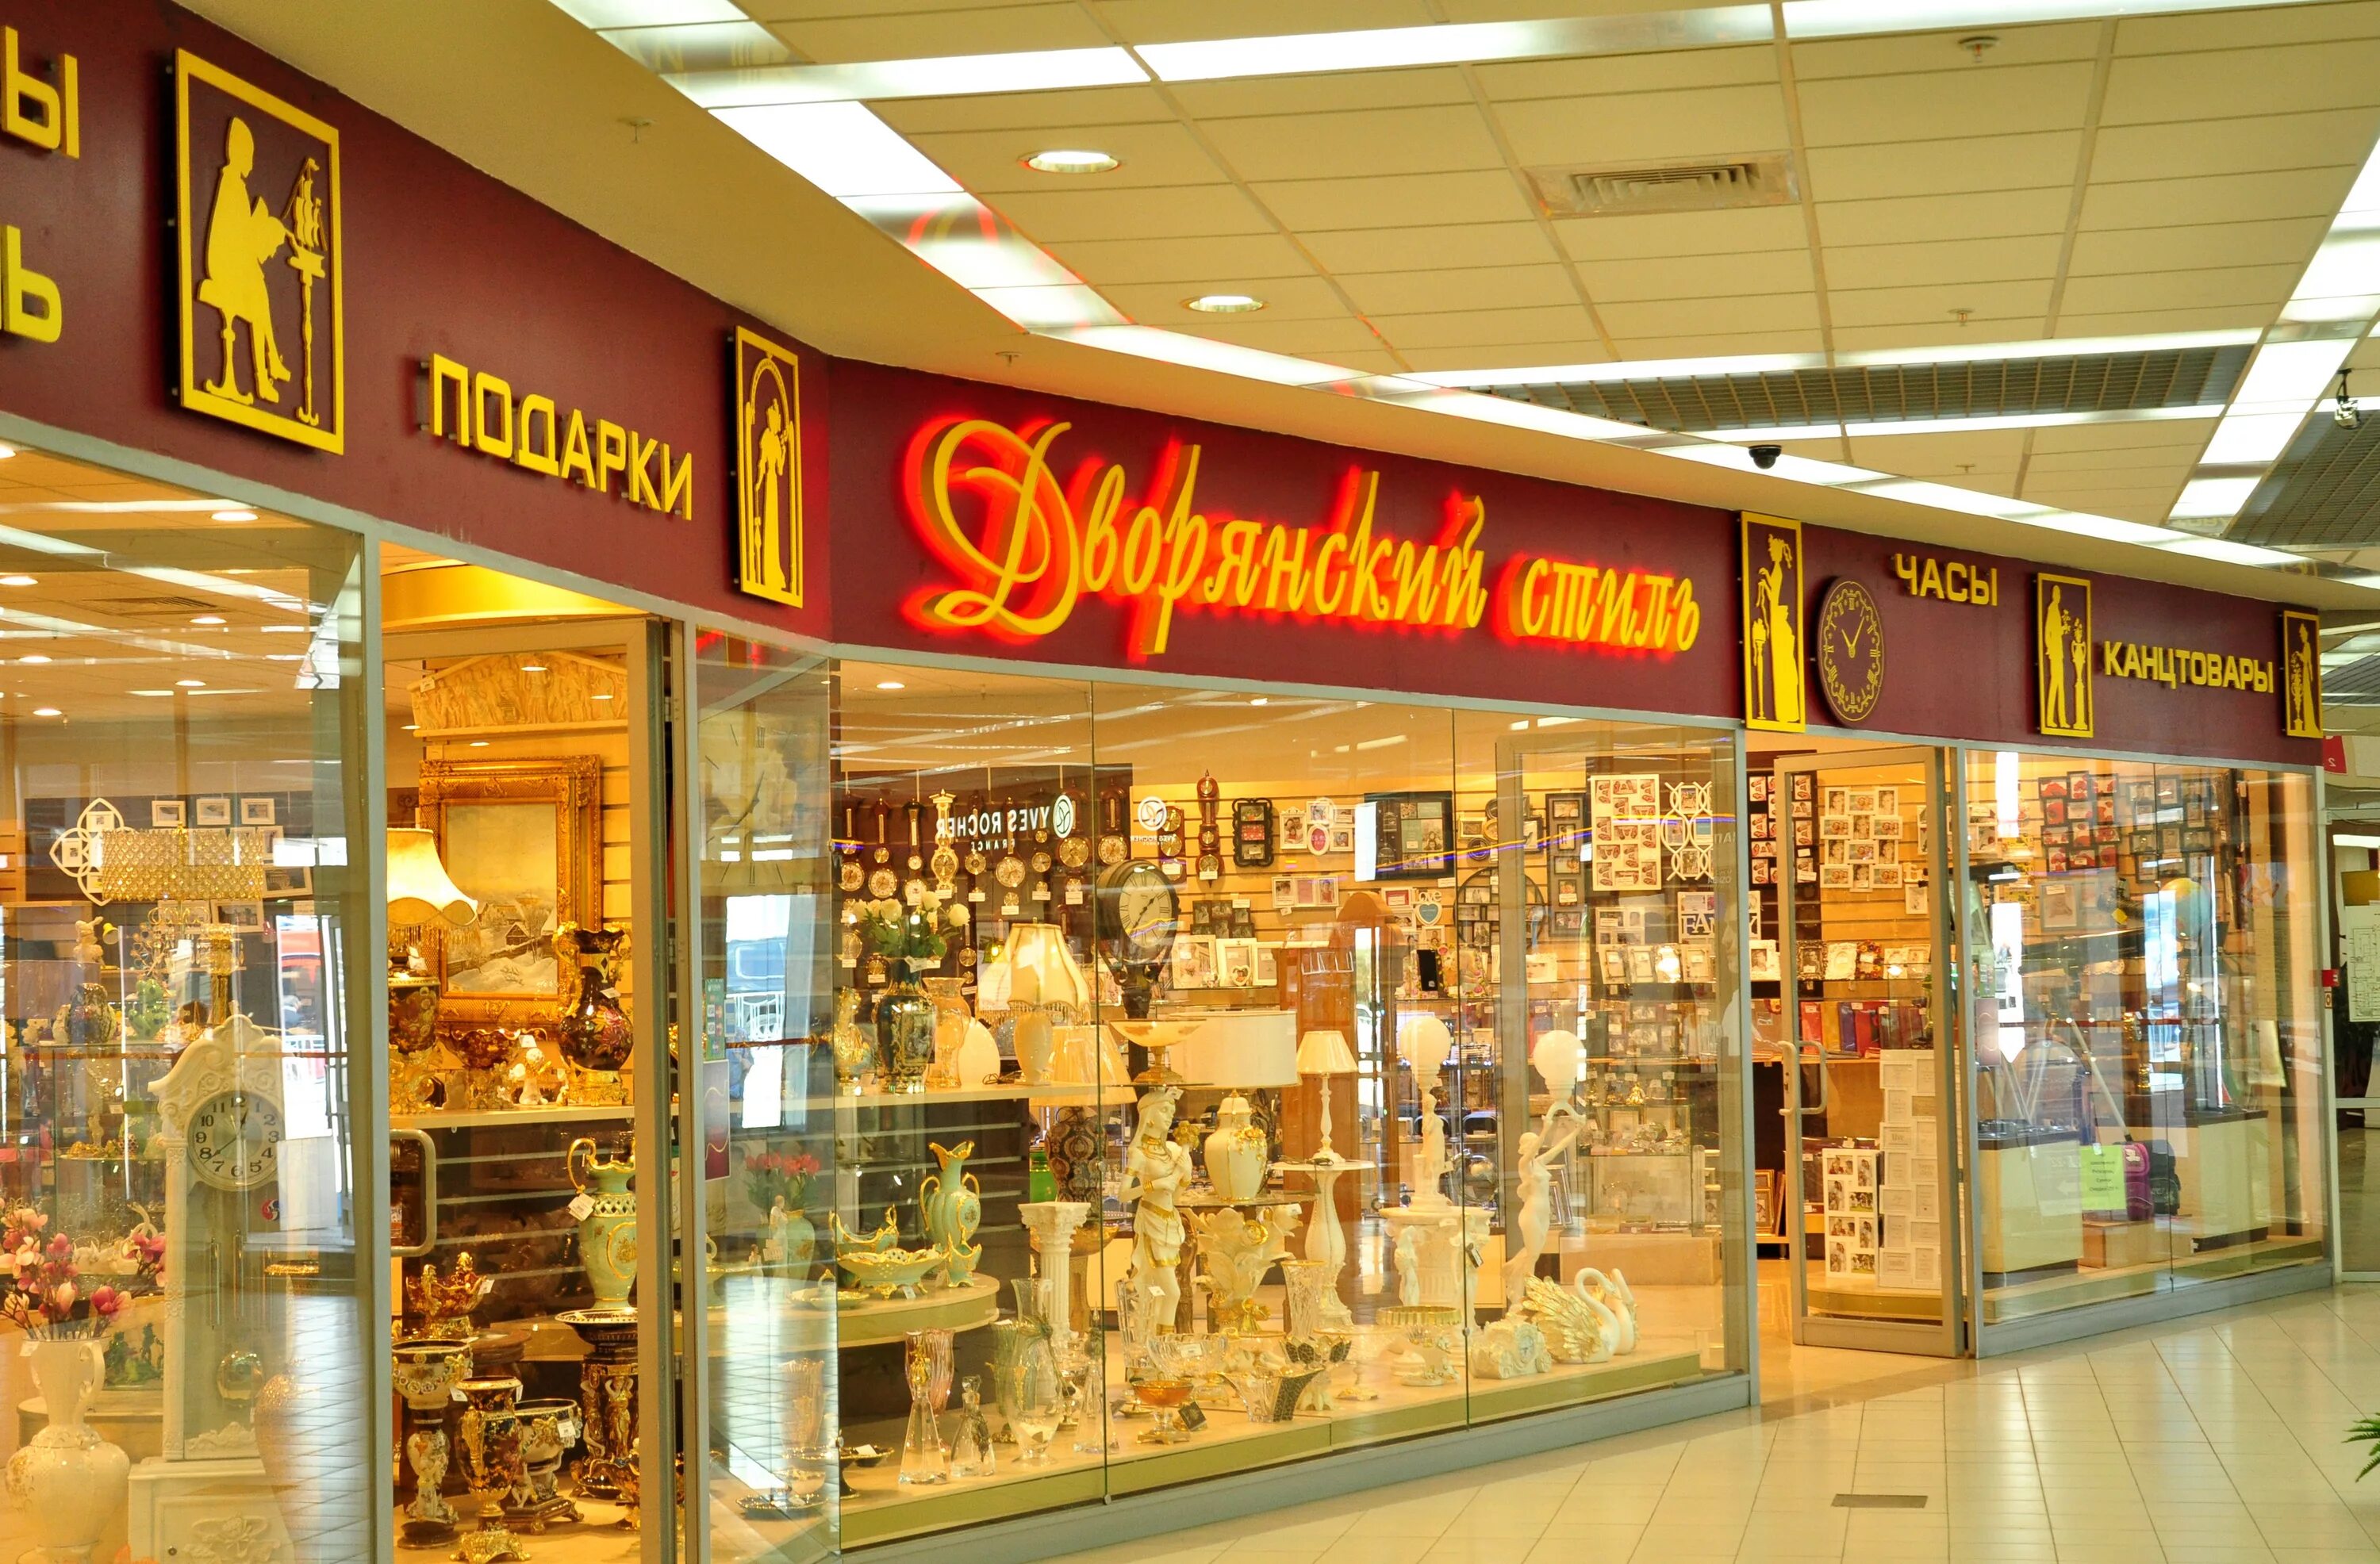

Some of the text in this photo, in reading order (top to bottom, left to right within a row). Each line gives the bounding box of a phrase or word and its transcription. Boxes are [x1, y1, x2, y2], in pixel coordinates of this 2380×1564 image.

[0, 224, 63, 343] Ь
[428, 352, 693, 522] ПОДАРКИ
[930, 419, 1700, 655] Дворянский стиль
[1893, 553, 1998, 607] ЧАСЫ
[2104, 639, 2274, 694] КАНЦТОВАРЫ
[212, 1102, 225, 1113] 11
[200, 1114, 214, 1127] 10
[263, 1114, 276, 1126] 2
[195, 1131, 207, 1144] 9
[267, 1130, 280, 1144] 3
[199, 1147, 213, 1160] 8
[261, 1147, 274, 1159] 4
[213, 1160, 225, 1173] 7
[230, 1165, 244, 1178] 6
[250, 1160, 262, 1173] 5
